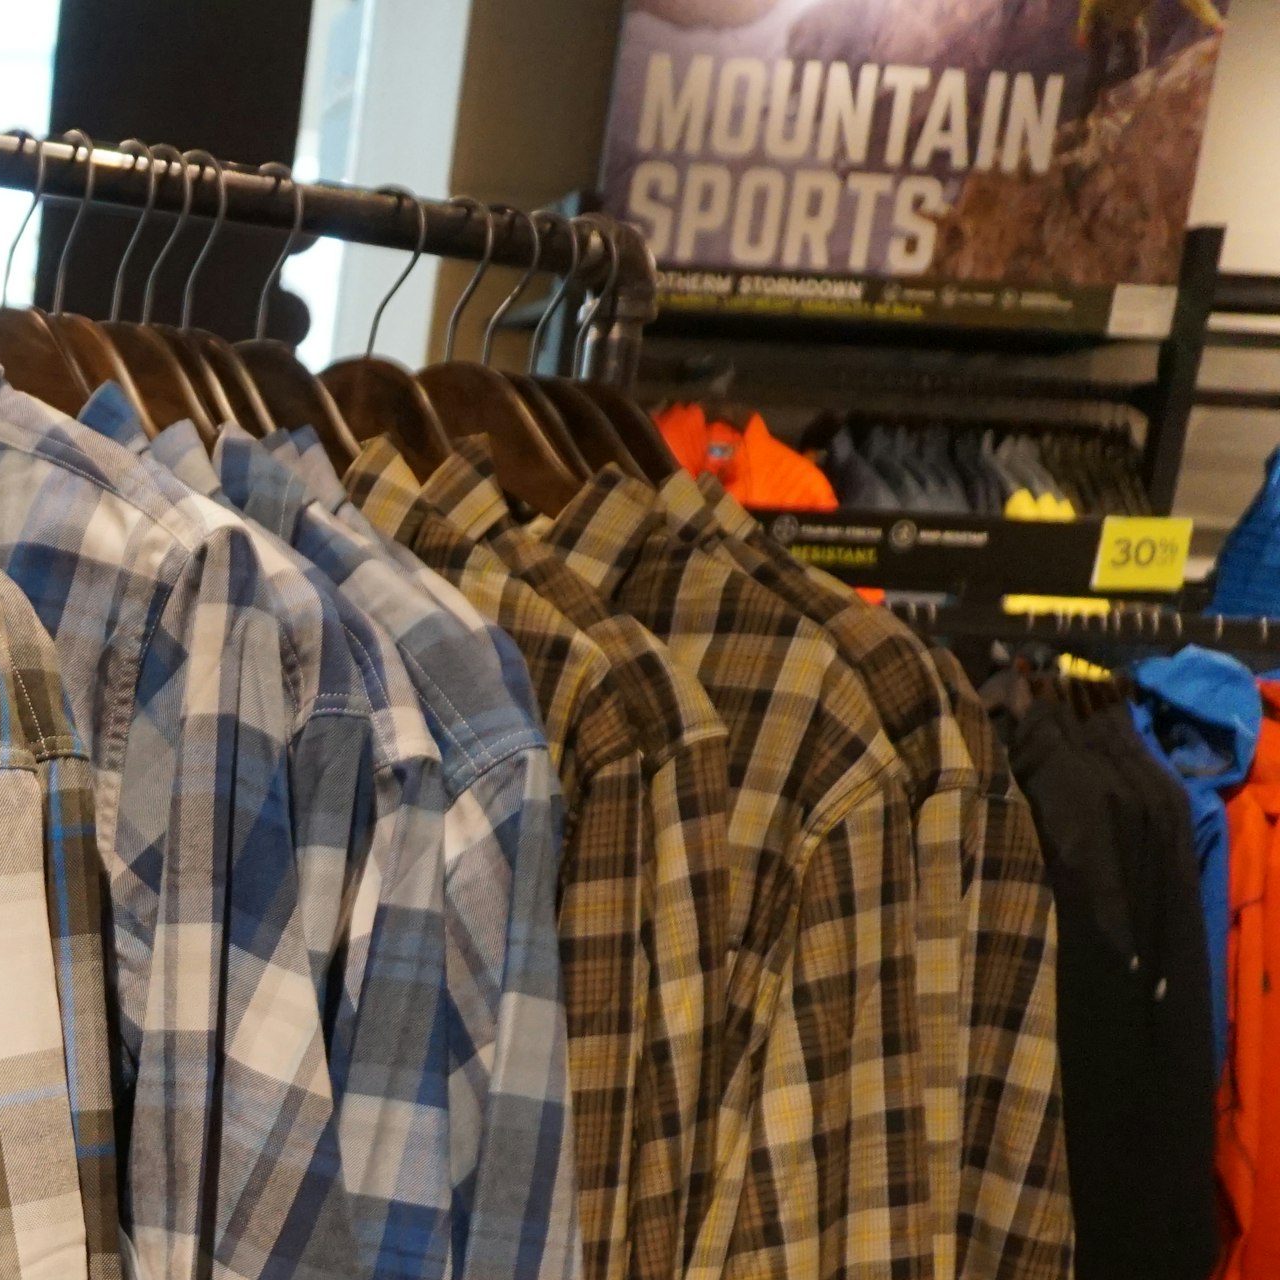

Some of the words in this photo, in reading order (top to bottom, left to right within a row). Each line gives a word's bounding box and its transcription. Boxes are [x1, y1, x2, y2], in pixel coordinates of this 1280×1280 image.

[639, 52, 1066, 175] MOUNTAIN
[627, 160, 946, 279] SPORTS
[655, 271, 732, 295] OTHERM
